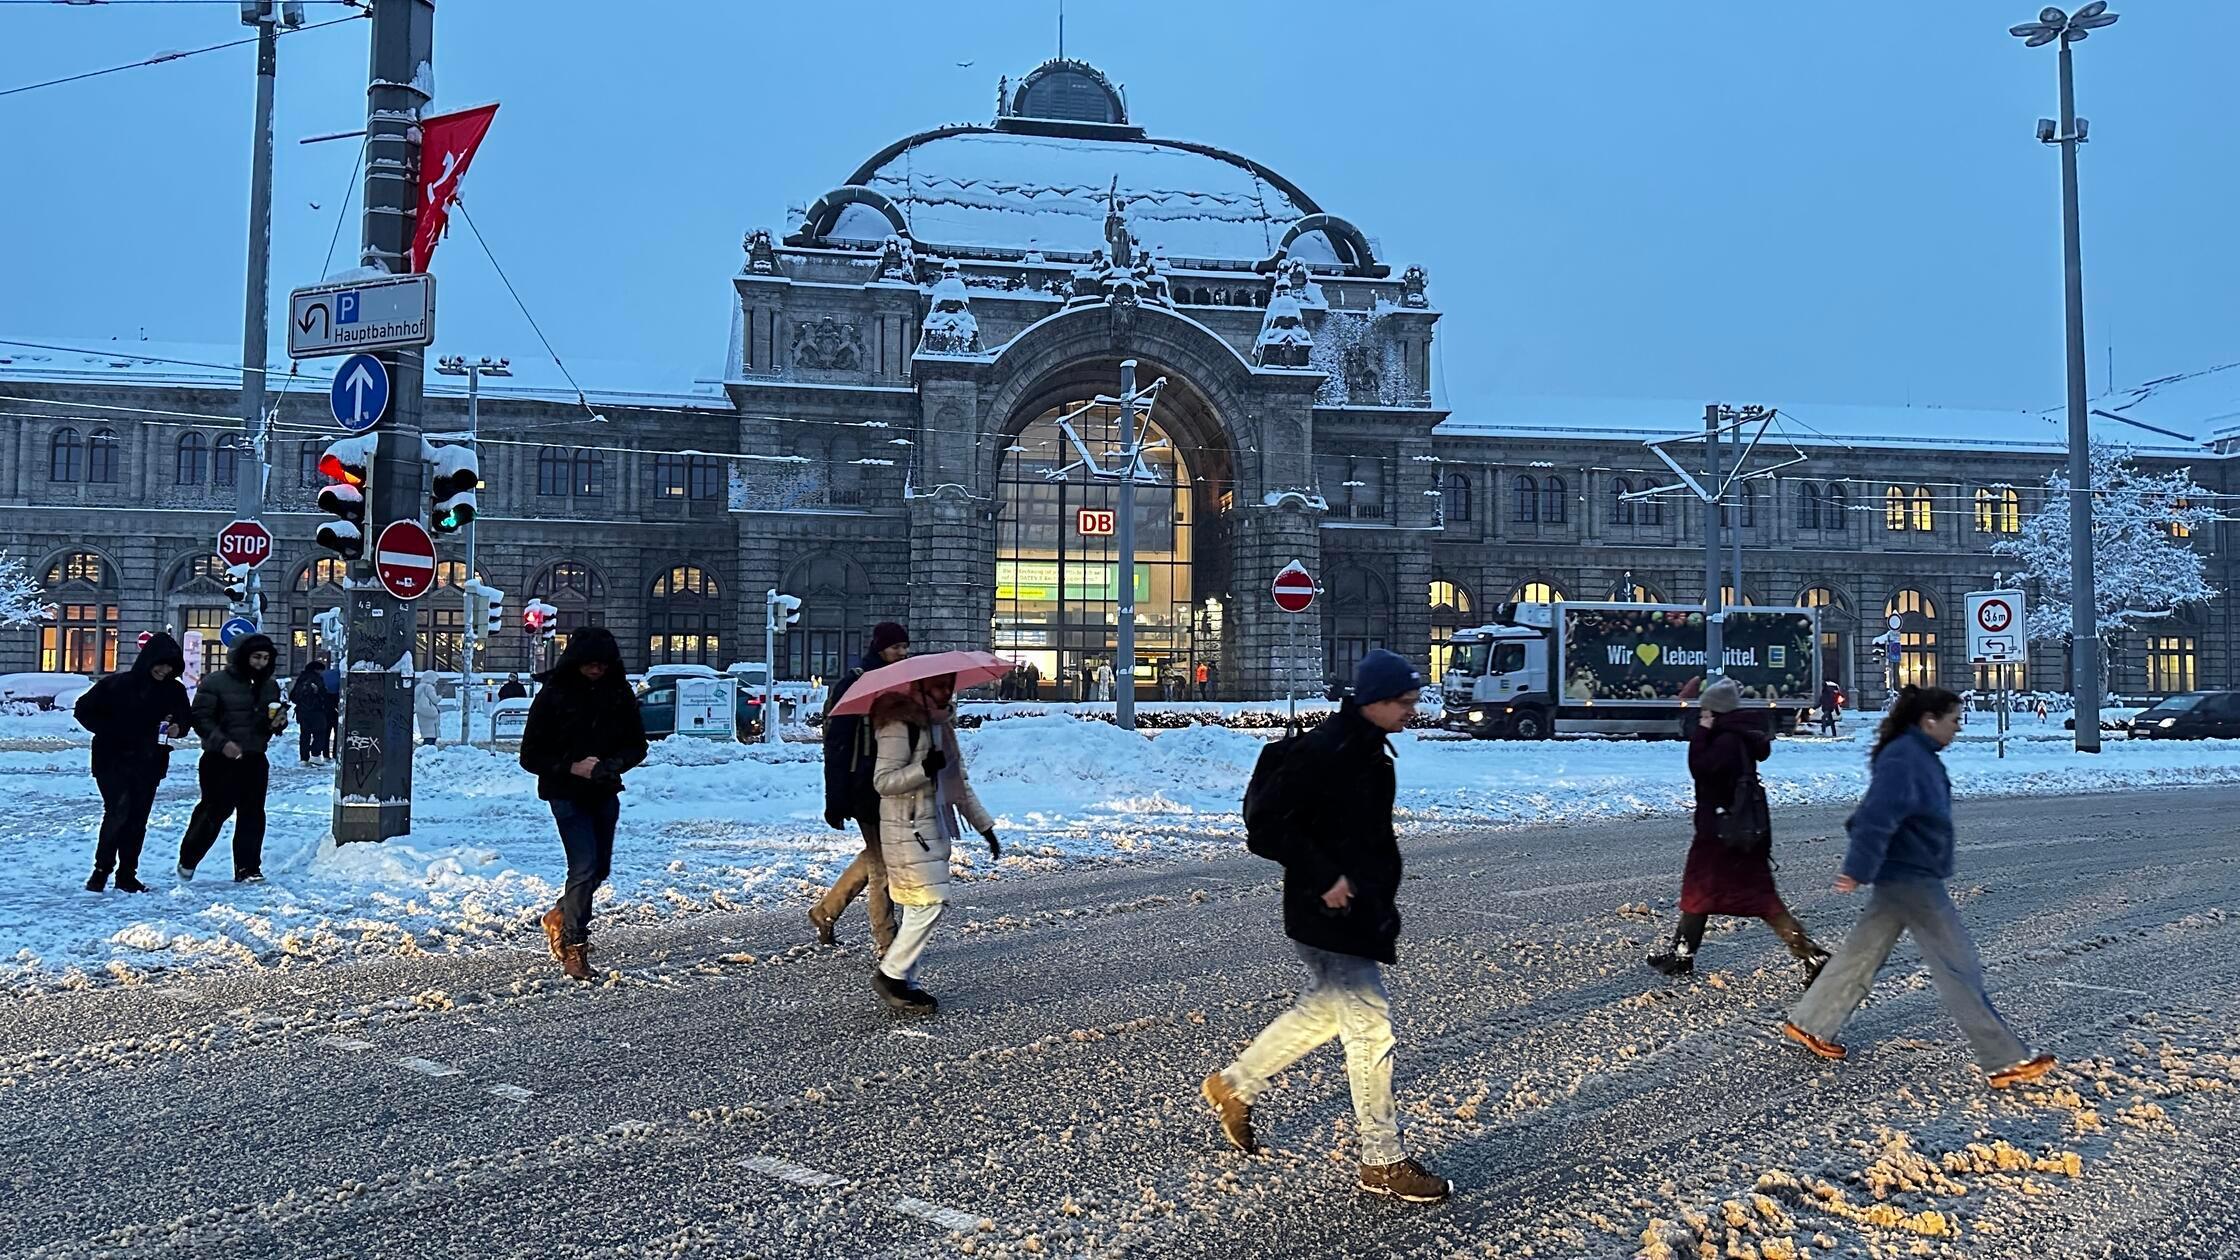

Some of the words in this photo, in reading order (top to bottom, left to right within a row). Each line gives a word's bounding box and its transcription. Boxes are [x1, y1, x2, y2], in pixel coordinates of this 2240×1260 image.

[341, 296, 354, 320] P
[335, 319, 424, 343] Hauptbahnhof
[1083, 513, 1112, 532] DB
[223, 534, 267, 555] STOP
[1607, 645, 1633, 665] Wir
[1662, 646, 1759, 666] Lebenittel.
